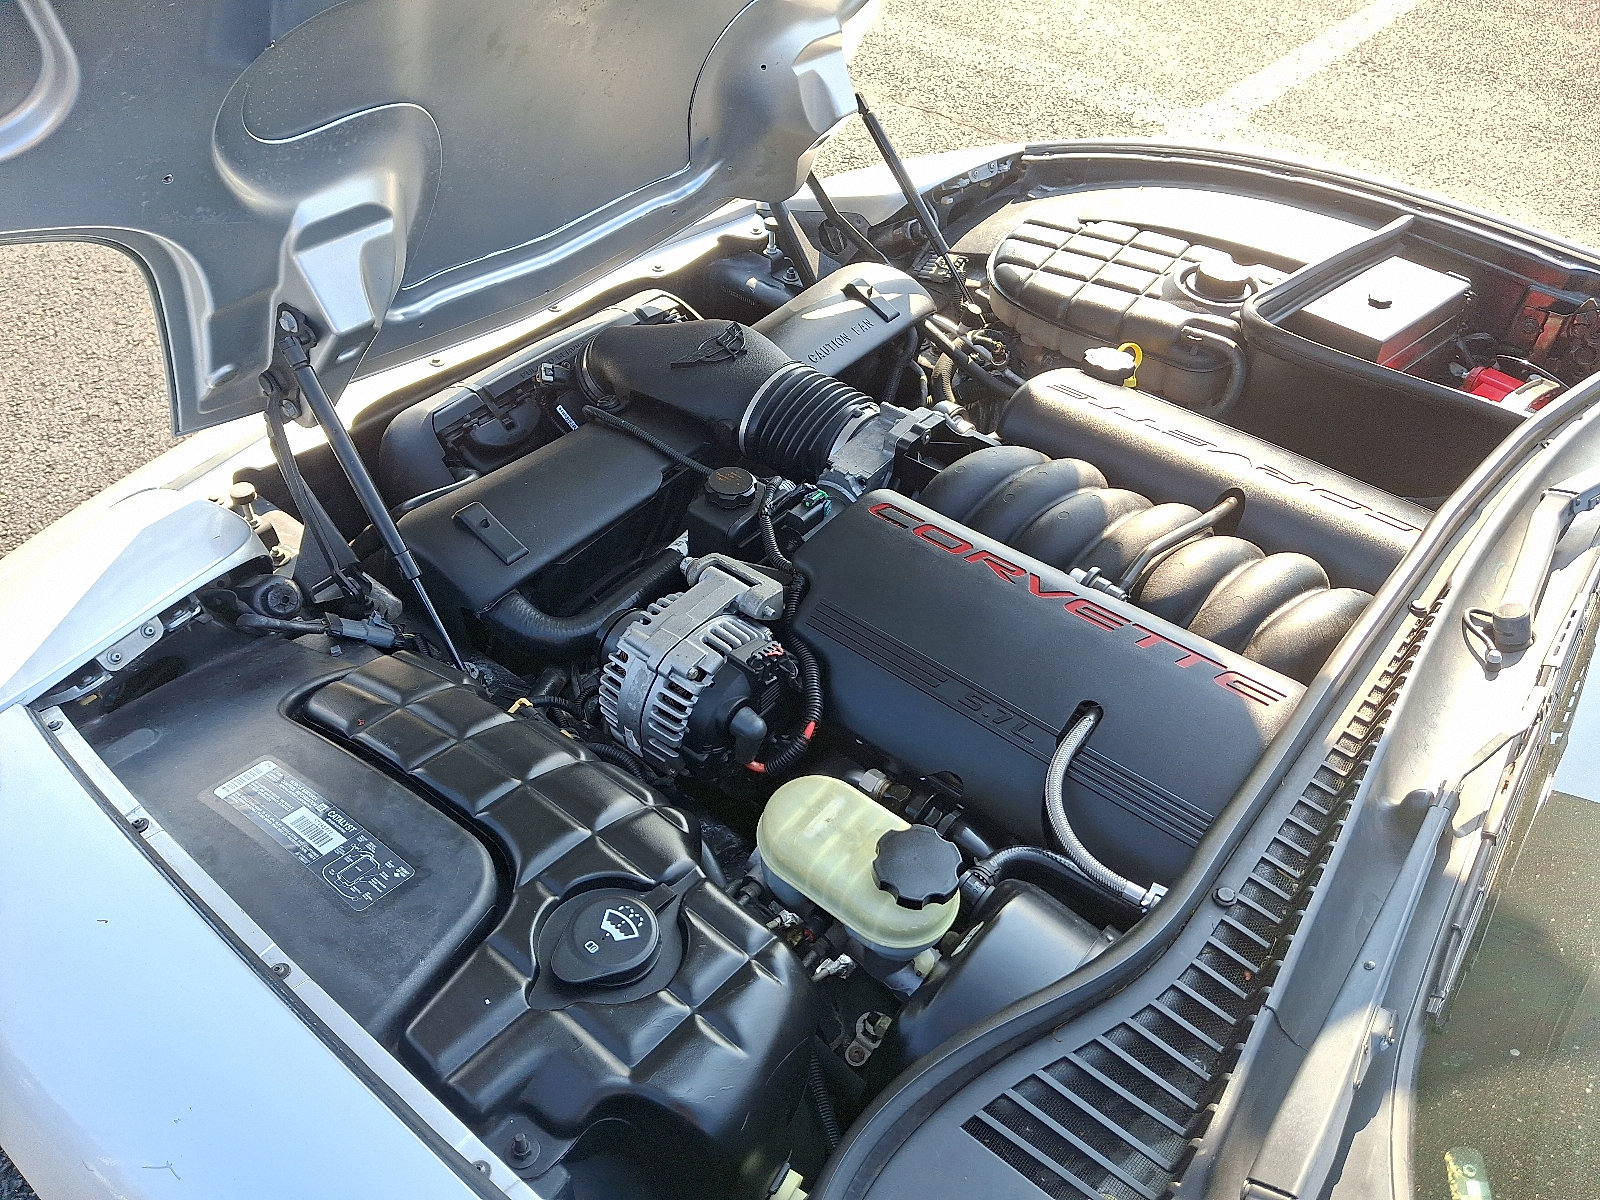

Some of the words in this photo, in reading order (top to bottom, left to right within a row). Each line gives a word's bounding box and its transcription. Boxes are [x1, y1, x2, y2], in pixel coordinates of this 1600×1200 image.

[807, 332, 852, 364] CAUTION
[850, 318, 875, 336] FAN
[1046, 383, 1424, 534] CORVETTE
[868, 502, 1288, 706] CORVETTE
[958, 694, 1034, 744] 5.7L
[328, 810, 357, 833] CATALYST
